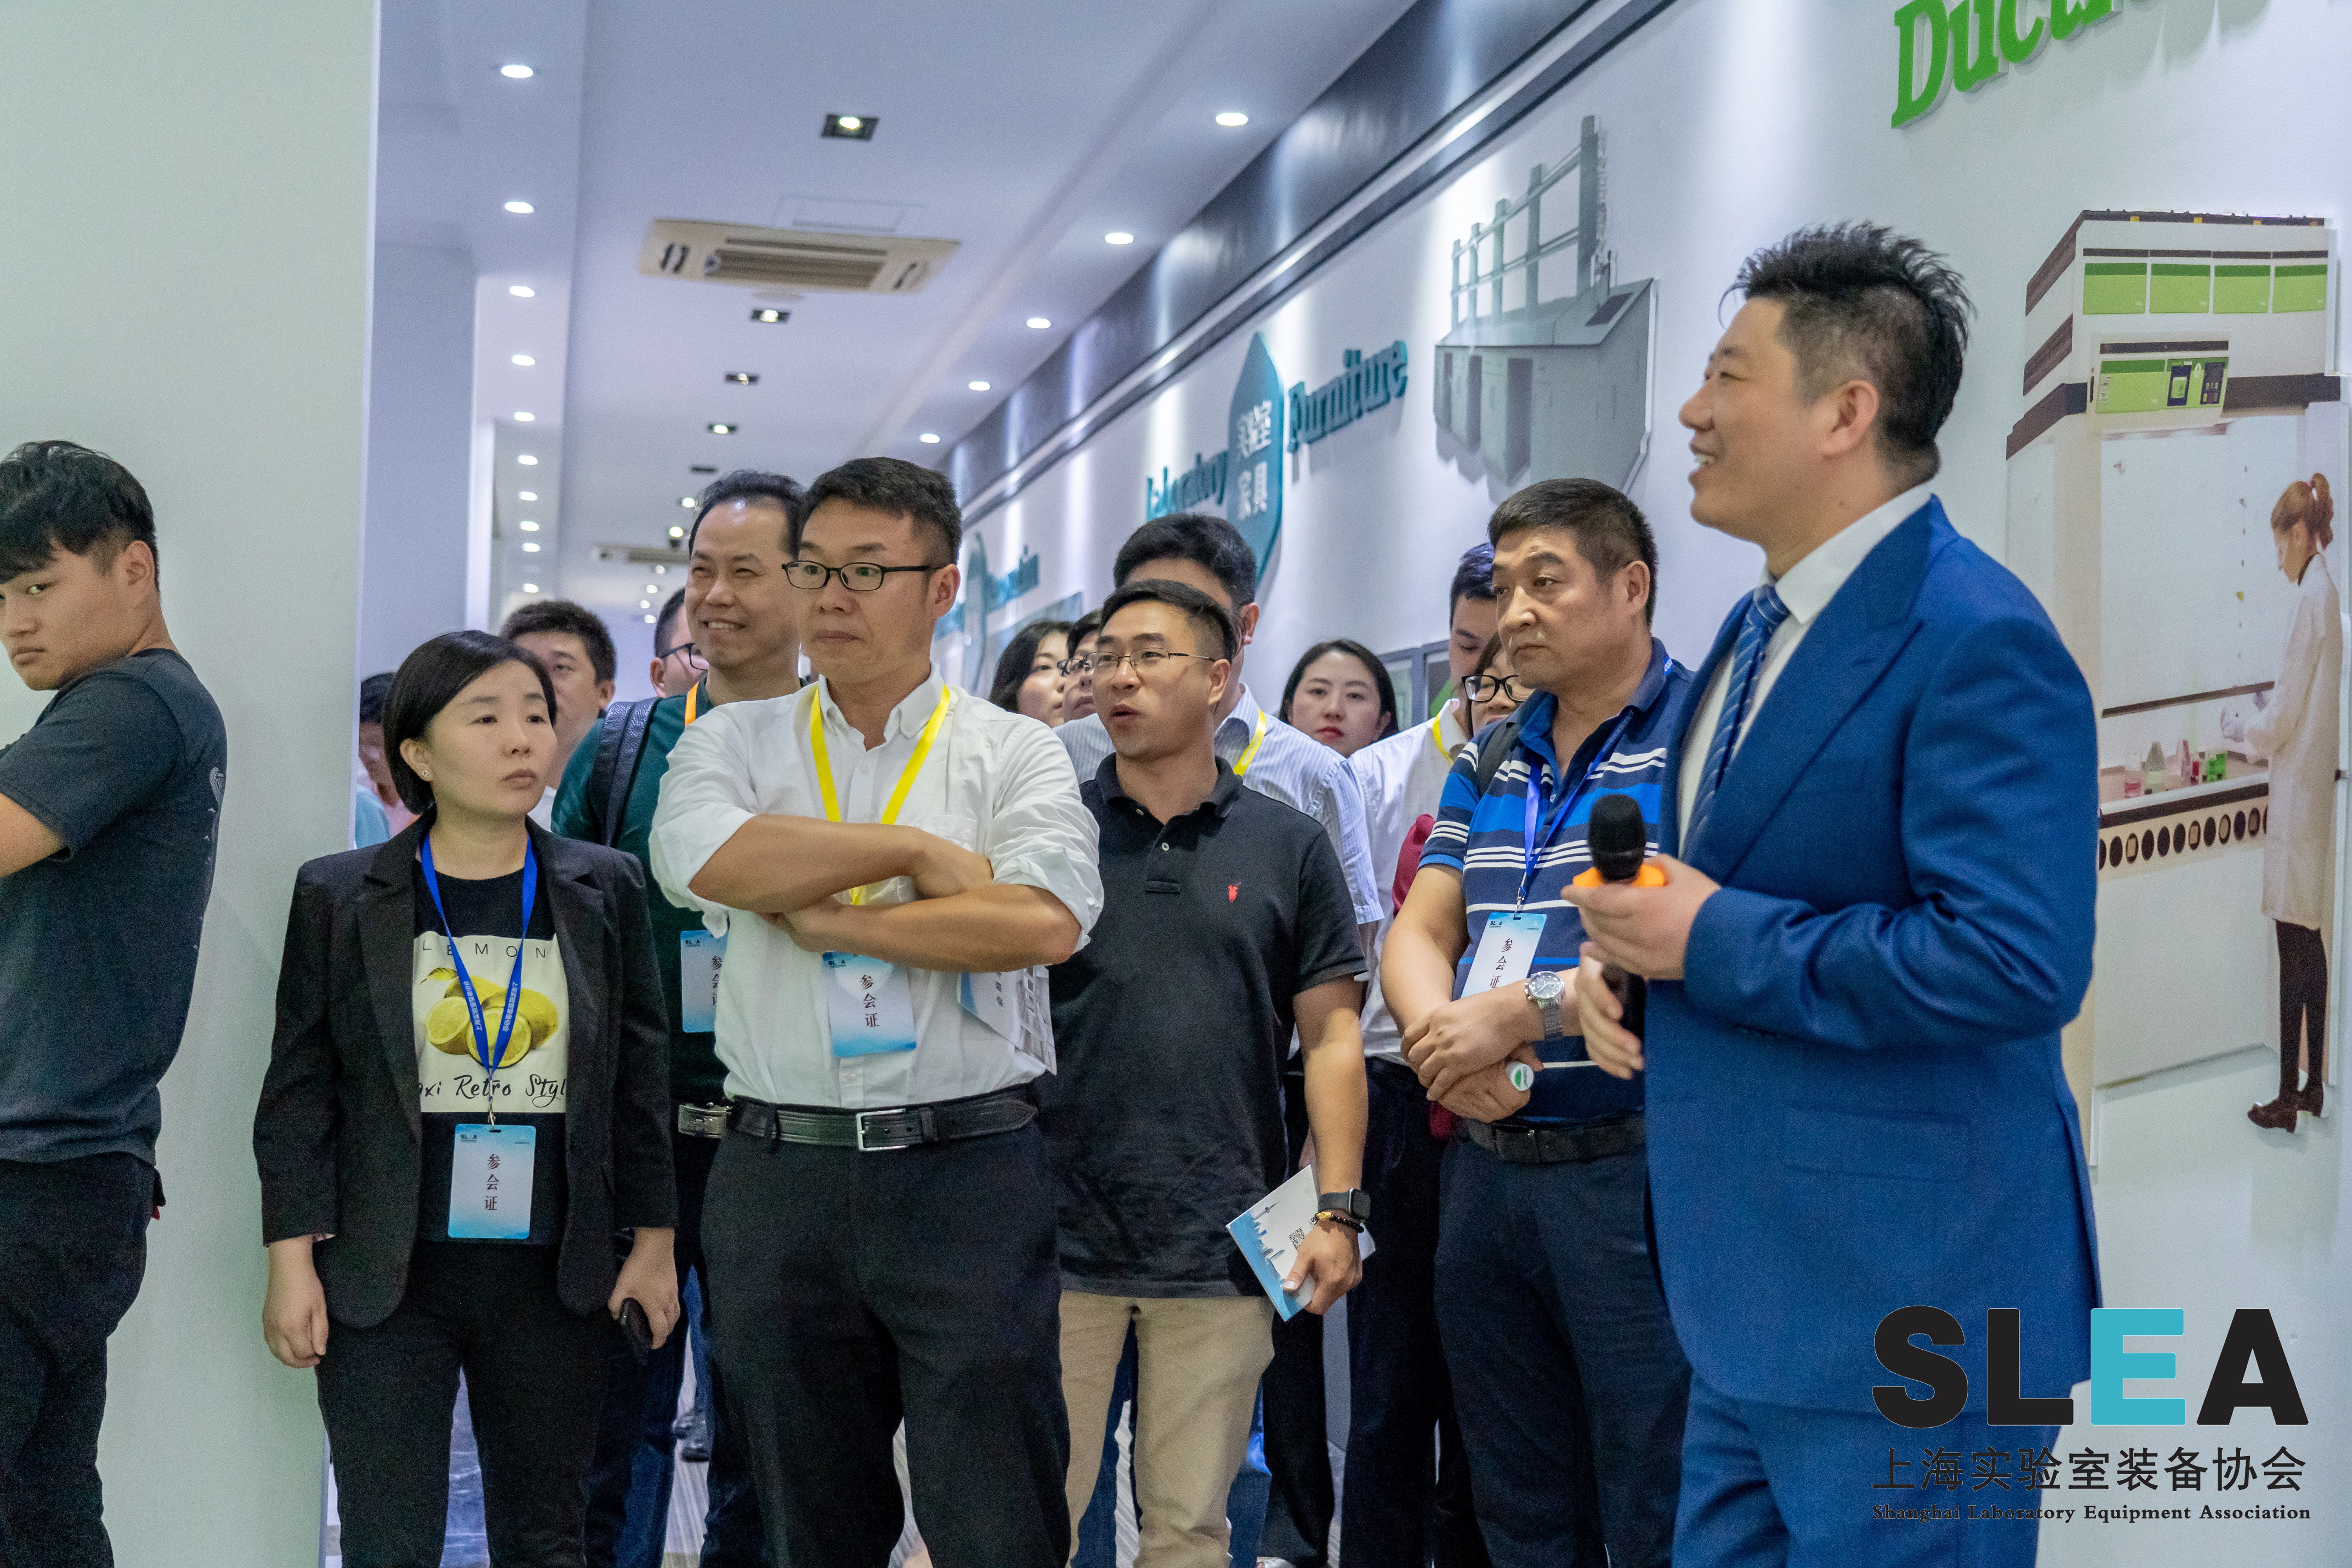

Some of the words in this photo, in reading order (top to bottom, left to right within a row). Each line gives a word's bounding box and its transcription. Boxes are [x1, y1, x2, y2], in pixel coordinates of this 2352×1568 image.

[1490, 937, 1513, 988] 参会证
[860, 975, 880, 1028] 参会证
[454, 1074, 511, 1099] Retro
[485, 1153, 501, 1211] 参会证
